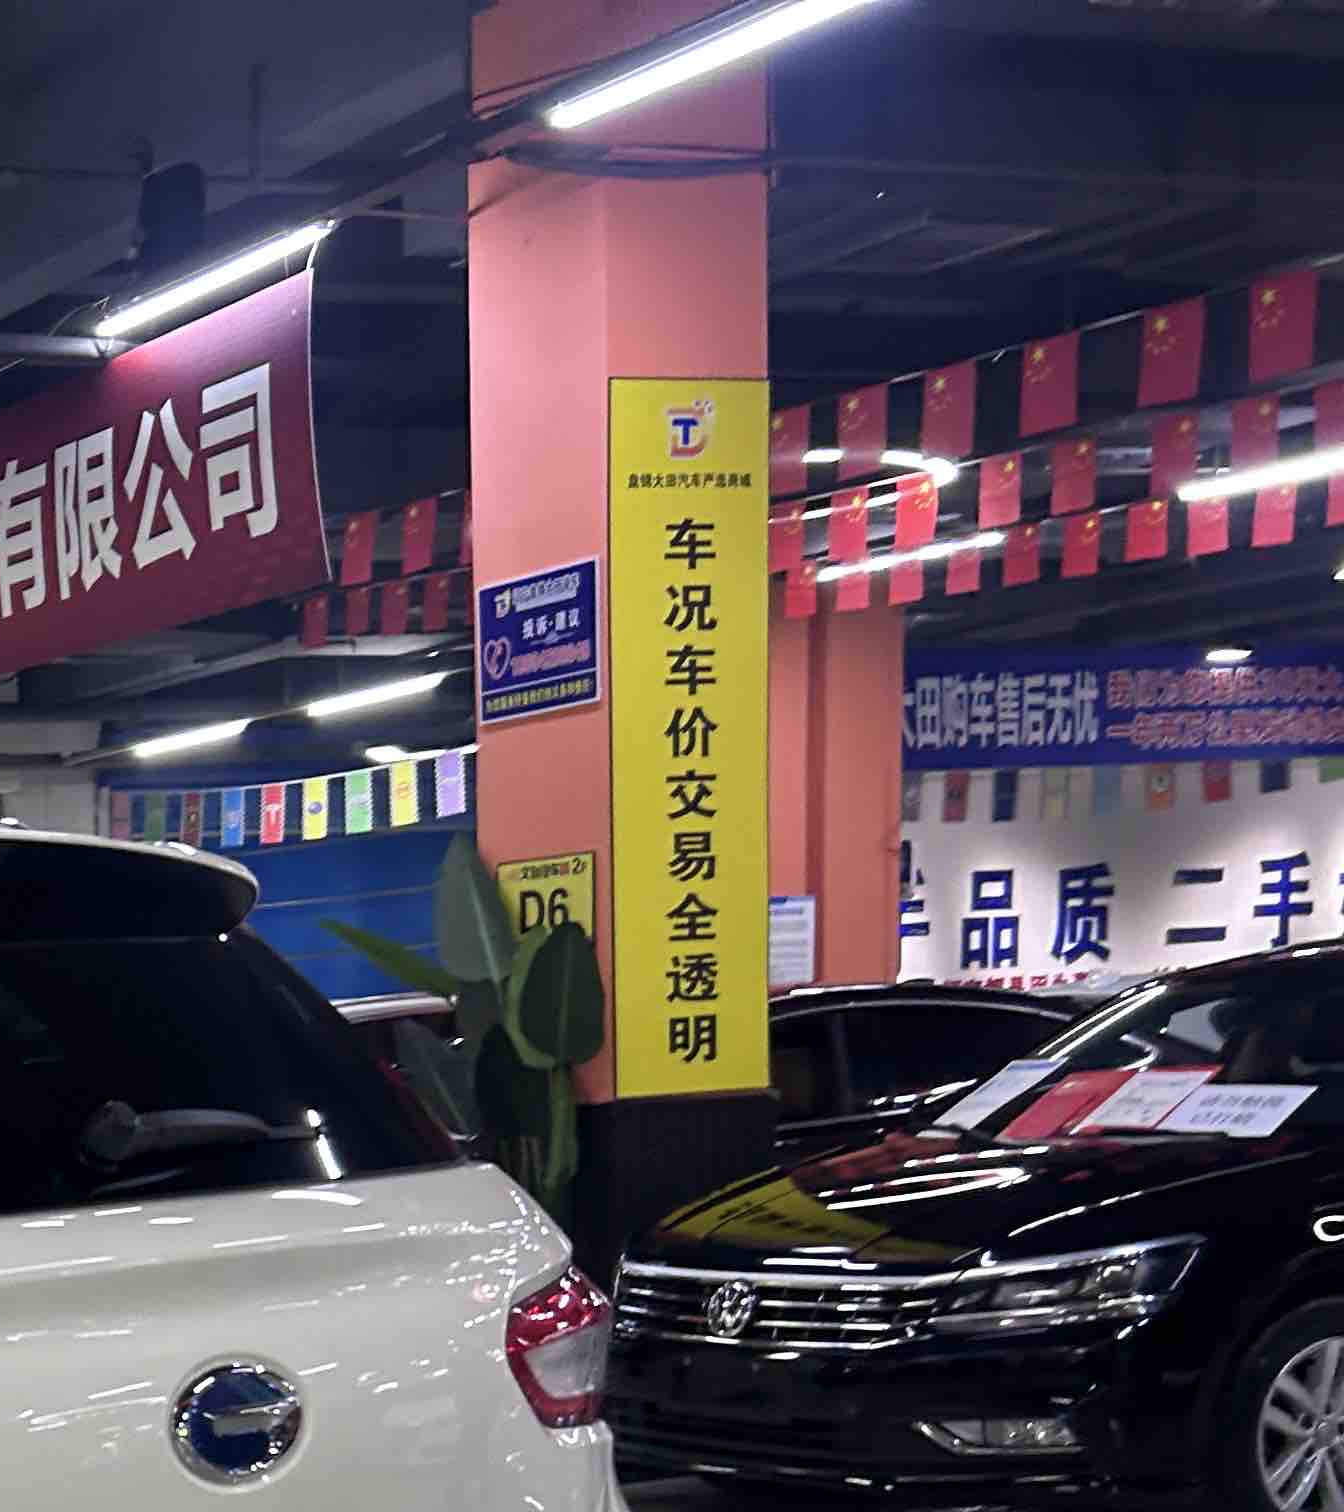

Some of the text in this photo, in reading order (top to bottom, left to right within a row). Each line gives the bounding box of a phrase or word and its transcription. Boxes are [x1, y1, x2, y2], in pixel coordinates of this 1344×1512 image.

[519, 887, 569, 935] D6
[664, 517, 719, 1063] 车况车价交易全透明
